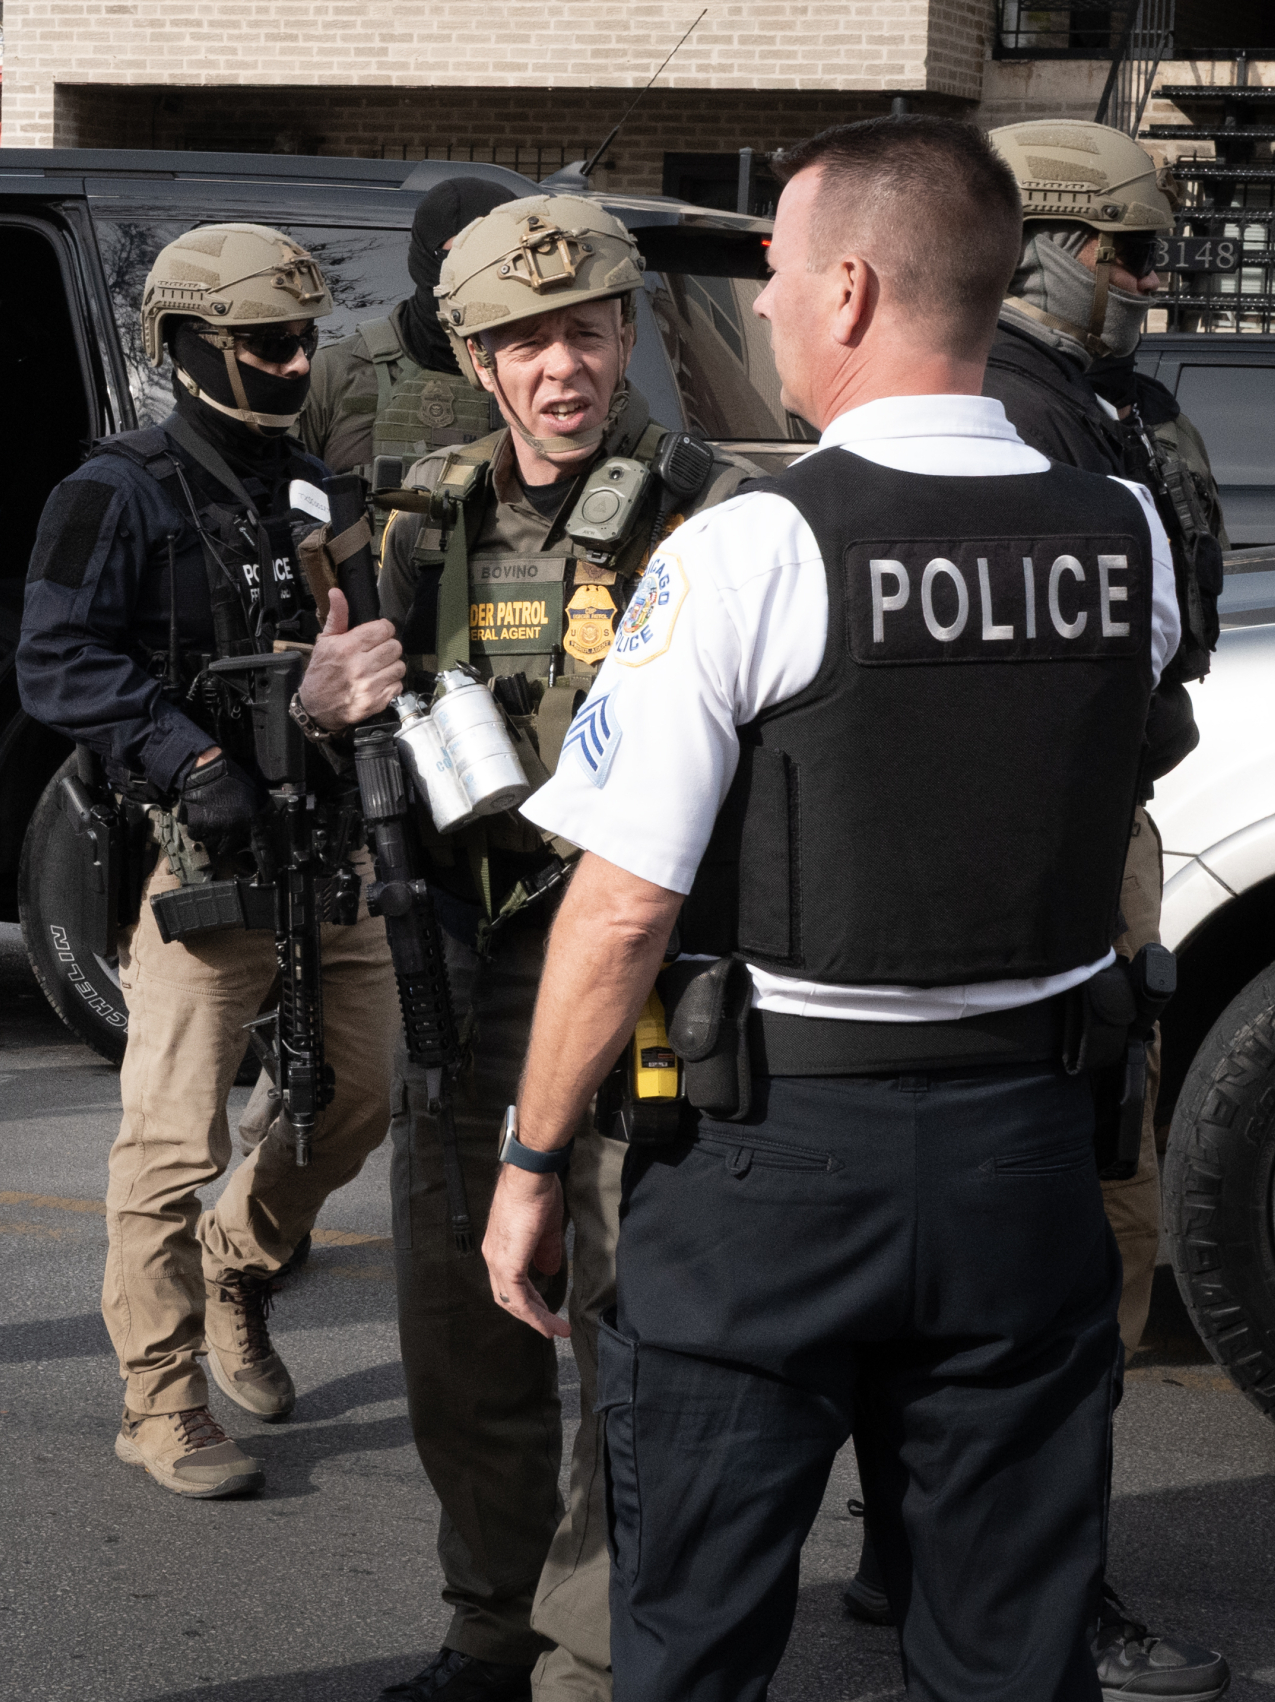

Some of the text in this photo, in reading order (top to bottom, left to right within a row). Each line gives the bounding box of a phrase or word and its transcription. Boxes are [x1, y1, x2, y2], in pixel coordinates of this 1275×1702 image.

[1155, 238, 1235, 269] 3148
[481, 564, 539, 579] BOVINO
[869, 554, 1130, 643] POLICE
[496, 600, 549, 626] PATROL
[500, 626, 542, 640] AGENT
[603, 628, 610, 637] S
[50, 924, 129, 1034] CHELIN
